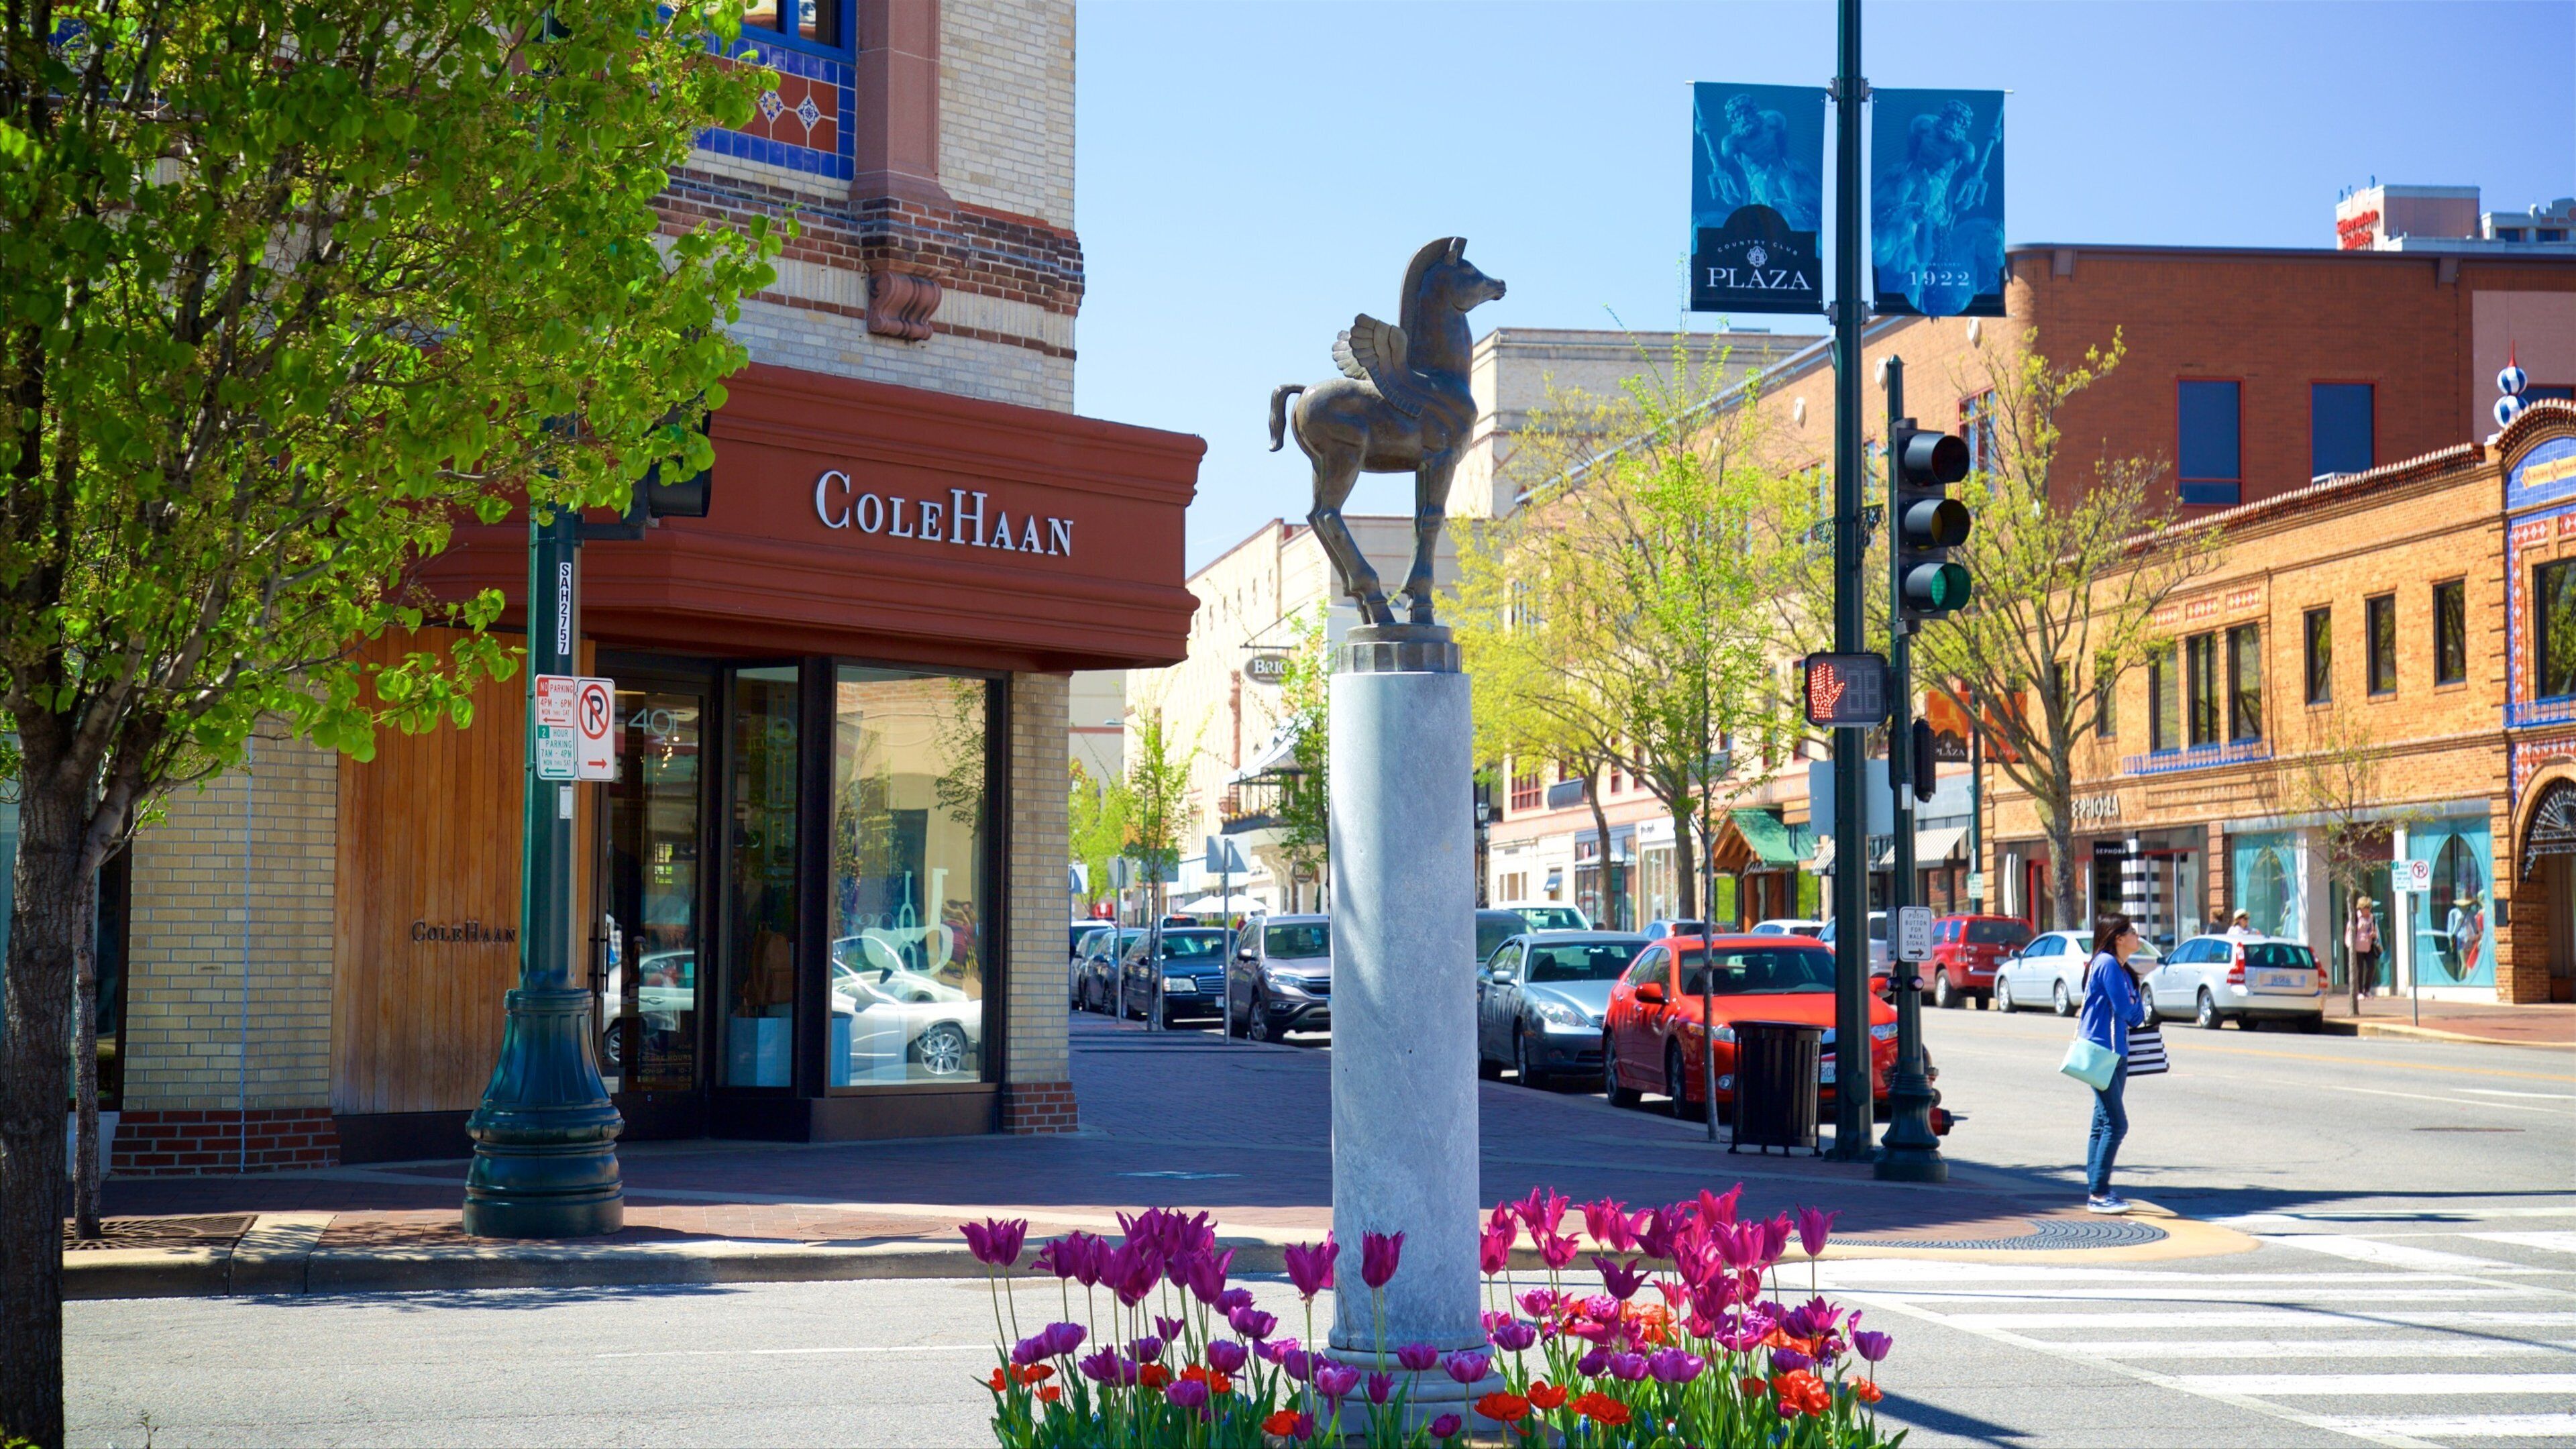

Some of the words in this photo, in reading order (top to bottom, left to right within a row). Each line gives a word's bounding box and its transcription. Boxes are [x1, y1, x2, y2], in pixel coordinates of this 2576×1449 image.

[1717, 239, 1766, 253] COUNTRY
[1773, 241, 1798, 256] CLUB
[1706, 267, 1813, 290] PLAZA
[1910, 270, 1970, 286] 1922
[540, 682, 548, 692] NO
[549, 684, 574, 694] PARKING
[540, 698, 553, 707] 4PM
[560, 699, 572, 708] 6PM
[541, 728, 546, 737] 2
[553, 729, 569, 737] HOUR
[545, 739, 572, 749] PARKING
[541, 748, 553, 757] 7AM
[560, 749, 572, 758] 4PM
[2072, 795, 2119, 819] EPHORA
